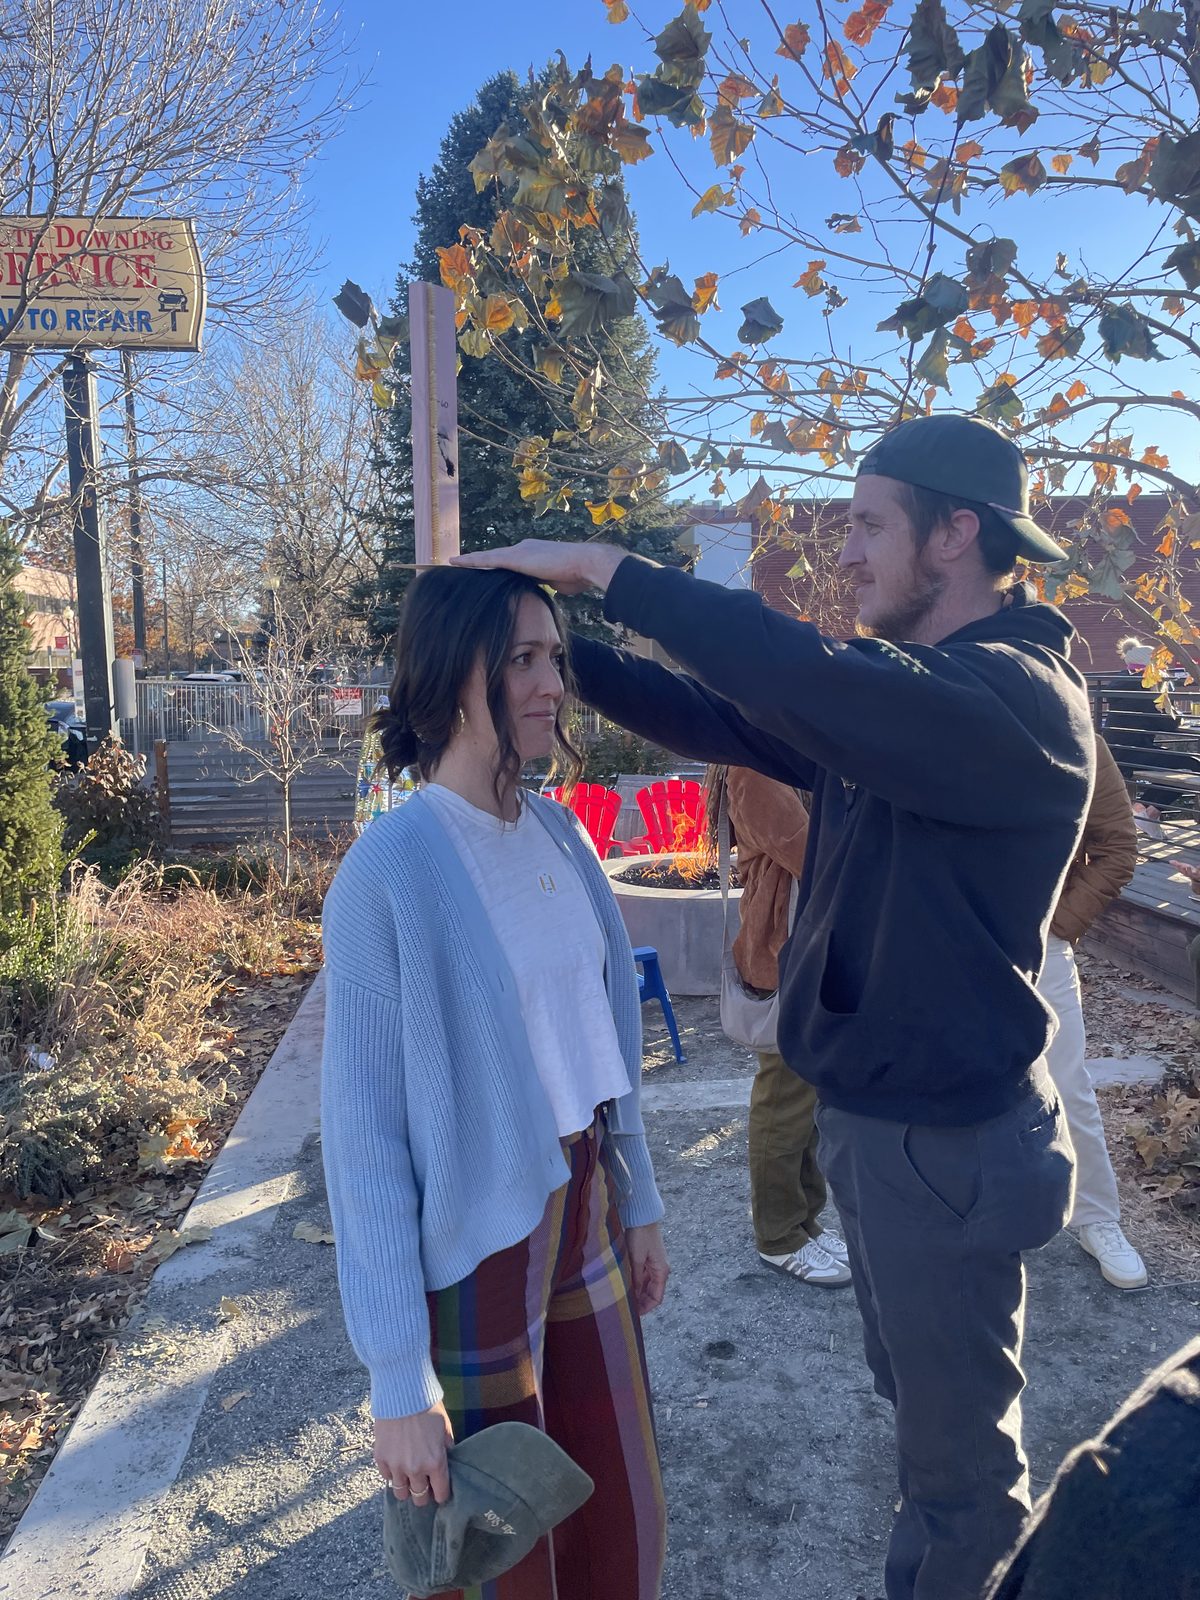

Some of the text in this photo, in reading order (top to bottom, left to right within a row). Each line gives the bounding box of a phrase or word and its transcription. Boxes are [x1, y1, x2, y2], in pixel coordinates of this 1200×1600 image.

[53, 225, 174, 250] DOWNING
[0, 252, 158, 289] ERVICE
[65, 308, 153, 333] REPAIR
